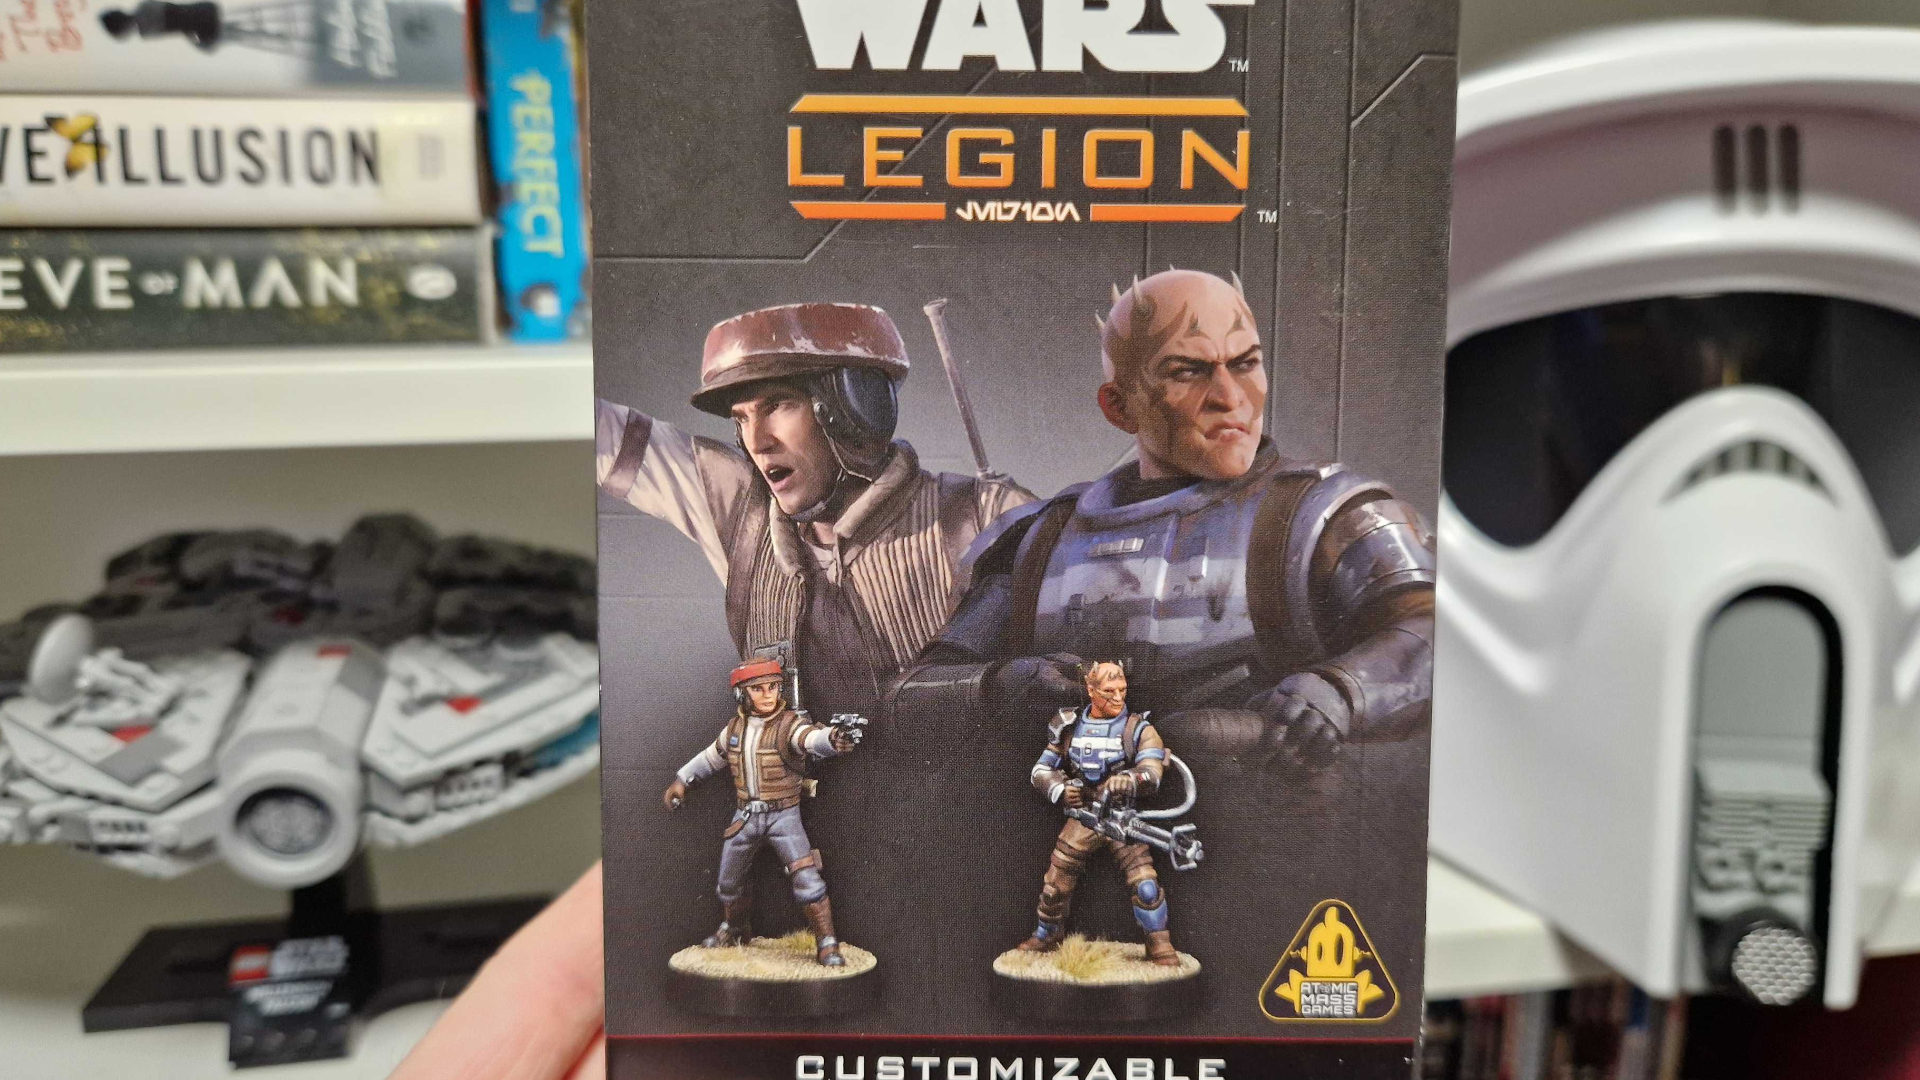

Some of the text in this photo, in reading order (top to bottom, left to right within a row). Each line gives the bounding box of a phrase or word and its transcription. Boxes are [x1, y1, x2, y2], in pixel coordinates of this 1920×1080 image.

[1228, 59, 1249, 73] TM
[509, 67, 564, 258] PERFECT
[787, 126, 1250, 190] LEGION
[1257, 209, 1277, 223] TM
[183, 256, 359, 310] MAN
[1301, 982, 1357, 994] ATOMIC
[1301, 994, 1357, 1005] MASS
[1301, 1005, 1354, 1015] GAMES
[796, 1055, 1226, 1080] CUSTOMIZABLE
